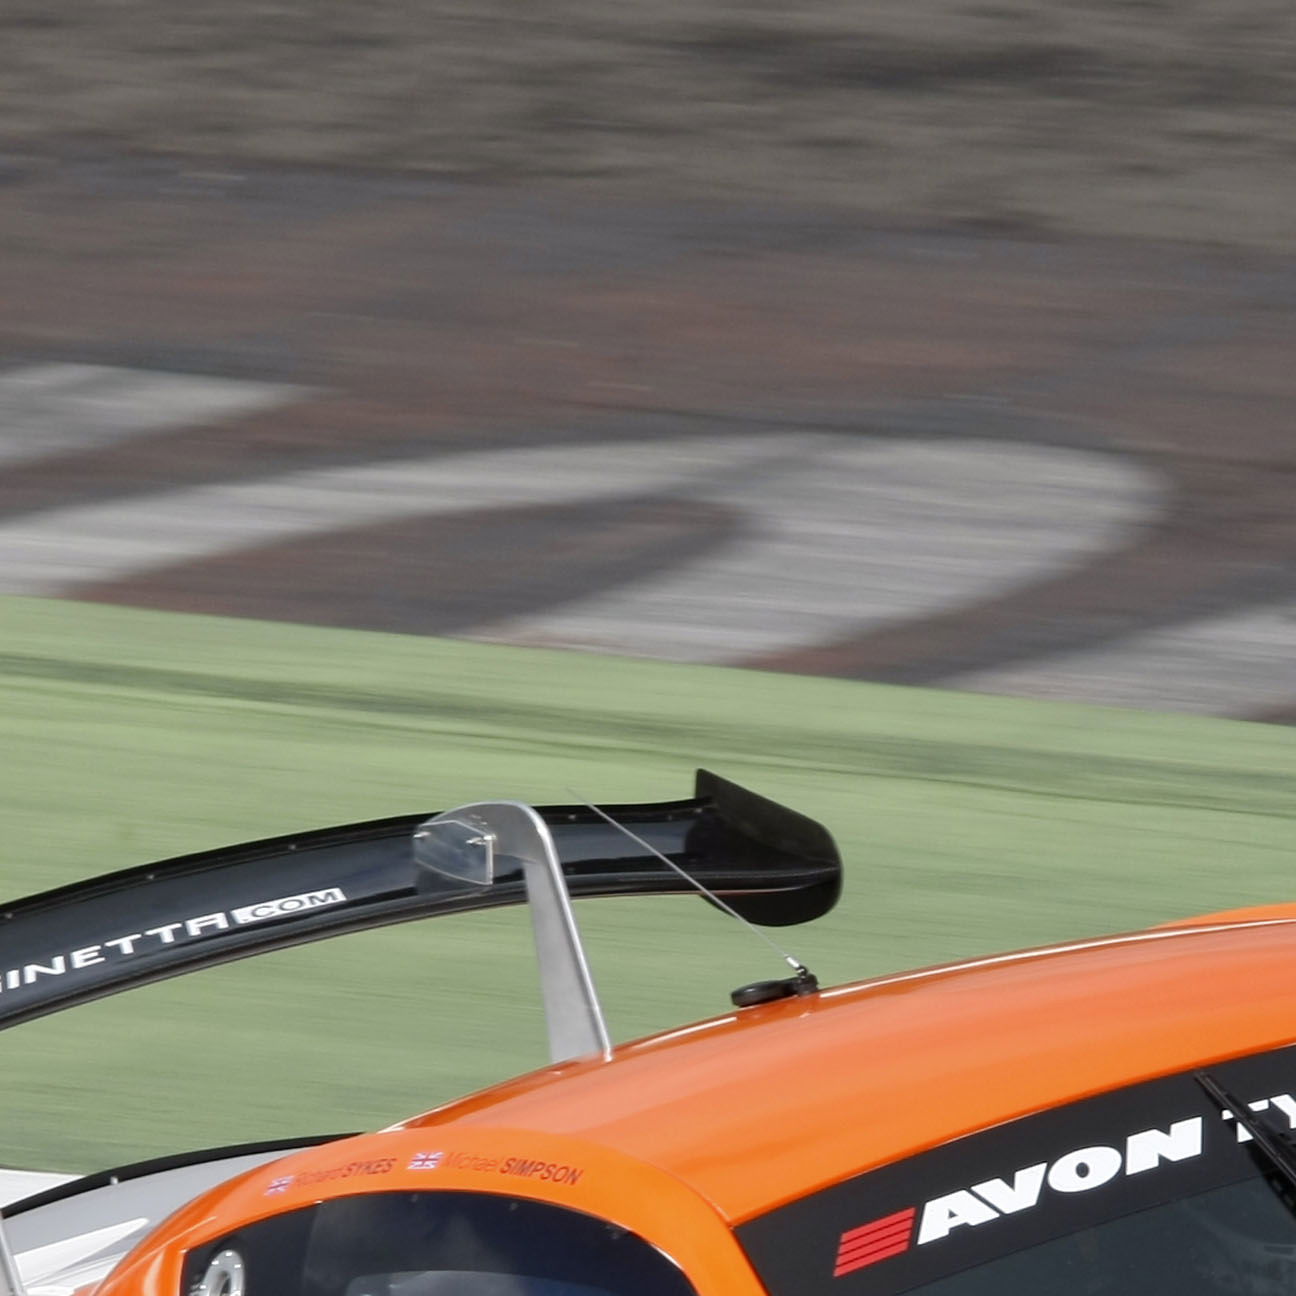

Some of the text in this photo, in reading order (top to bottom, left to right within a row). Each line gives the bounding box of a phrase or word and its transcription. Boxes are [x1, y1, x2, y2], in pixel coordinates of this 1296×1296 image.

[0, 888, 347, 993] INETTA.COM
[500, 1156, 585, 1186] SIMPSON
[917, 1117, 1202, 1245] AVON
